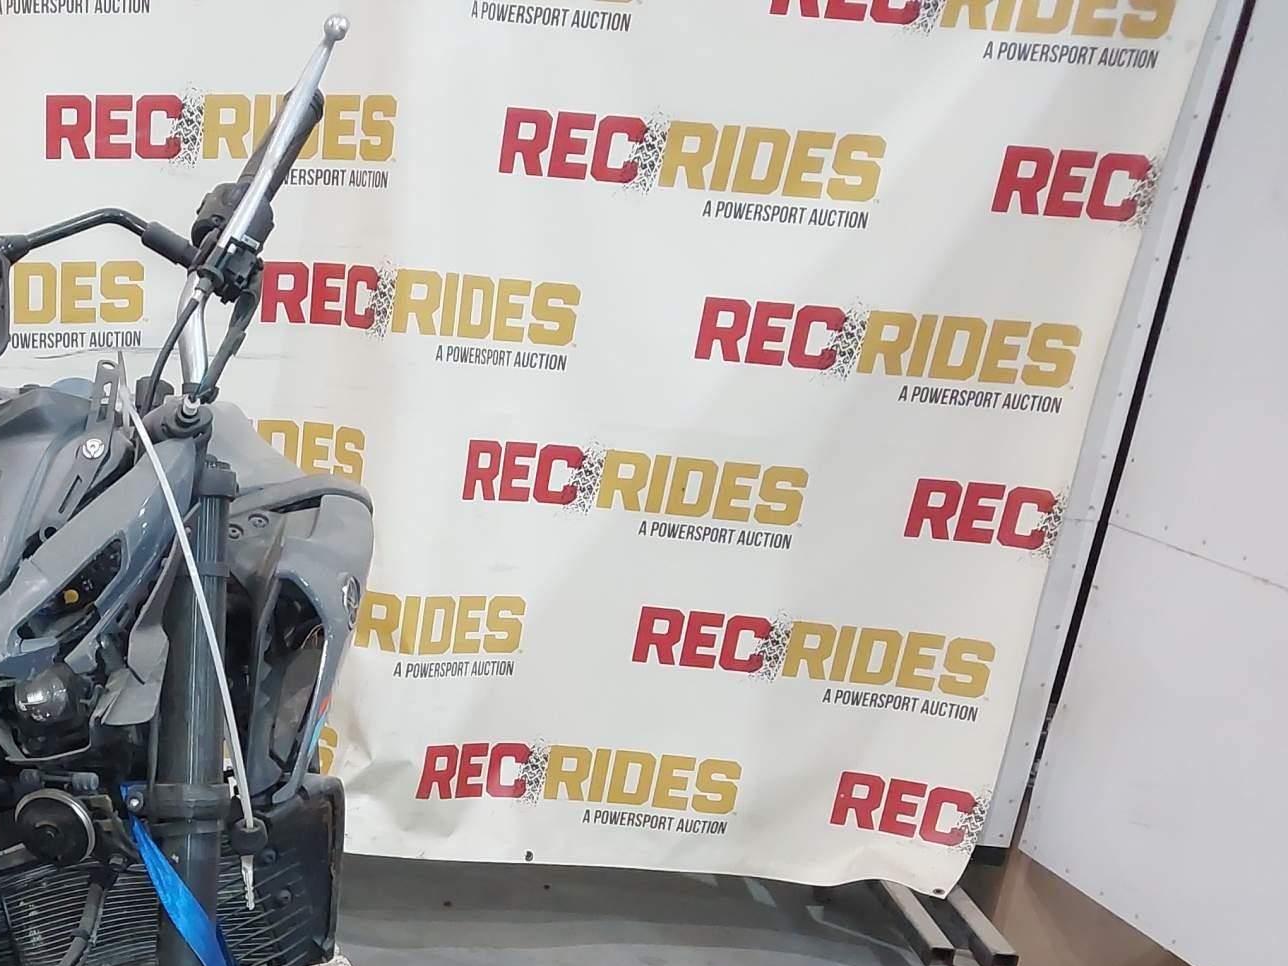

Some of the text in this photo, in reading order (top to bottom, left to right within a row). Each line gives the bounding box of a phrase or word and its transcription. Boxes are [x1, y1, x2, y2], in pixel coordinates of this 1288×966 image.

[6, 0, 88, 15] POWERSPORT
[94, 0, 150, 14] AUCTION
[471, 0, 631, 32] A POWERSPORT AUCTION
[983, 41, 1159, 69] A POWERSPORT AUCTION
[45, 94, 396, 161] REC RIES
[498, 108, 886, 202] REC RIDES
[284, 169, 388, 188] ERSPORT AUCTION
[991, 146, 1150, 222] REC
[702, 200, 868, 229] A POWERSPORT AUCTION
[13, 261, 144, 325] DES
[260, 262, 580, 347] REC RIDES
[9, 331, 141, 349] OWERSPORT AUCTION
[436, 345, 567, 371] A POWERSPORT AUCTION
[694, 298, 1082, 389] REC RIDES
[898, 385, 1062, 414] A POWERSPORT AUCTION
[257, 419, 365, 485] DES
[462, 440, 809, 527] REC RIDES
[638, 521, 792, 549] A POWERSPORT AUCTION
[903, 477, 1056, 551] REC
[353, 591, 526, 656] RIDES
[631, 605, 996, 698] REC RIDES
[393, 661, 514, 678] A POWERSPORT AUCTION
[822, 688, 978, 722] A POWERSPORT AUCTION
[416, 743, 743, 814] REC RIDES
[829, 771, 976, 847] REC
[582, 809, 728, 834] A POWERSPORT AUCTION
